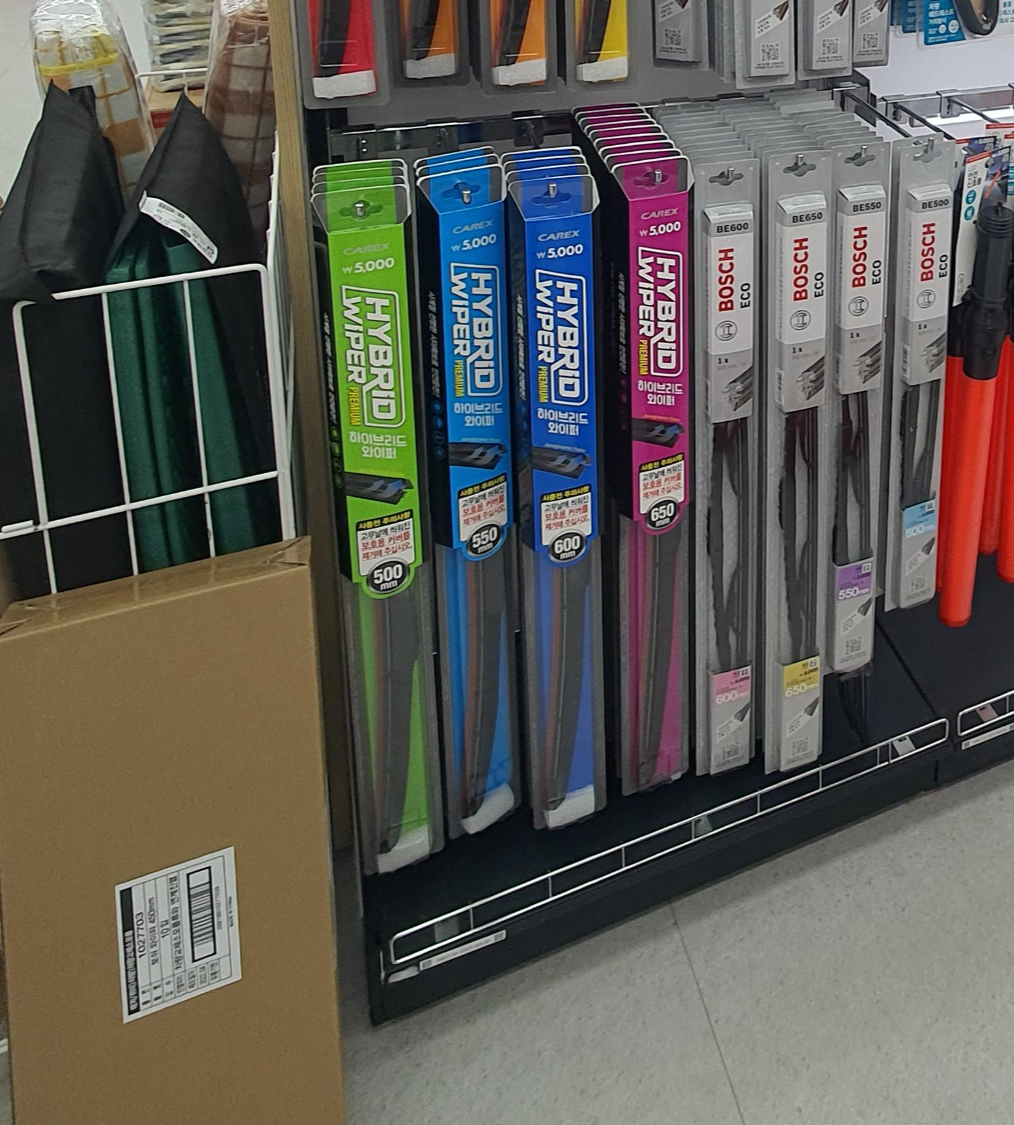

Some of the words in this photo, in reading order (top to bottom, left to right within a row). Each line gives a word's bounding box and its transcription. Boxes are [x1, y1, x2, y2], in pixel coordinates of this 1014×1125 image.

[641, 207, 679, 220] CAREX
[852, 201, 882, 212] BE550
[921, 198, 949, 209] BE500
[716, 222, 749, 234] BE600
[792, 211, 823, 223] BE650
[538, 229, 580, 242] CAREX
[851, 225, 868, 288] BOSCH
[920, 222, 936, 282] BOSCH
[793, 237, 809, 301] BOSCH
[871, 259, 882, 285] ECO
[939, 254, 949, 279] ECO
[717, 247, 735, 312] BOSCH
[814, 271, 825, 298] ECO
[638, 256, 655, 337] WIPER
[740, 282, 751, 309] ECO
[450, 272, 470, 356] WIPER
[535, 279, 555, 363] WIPER
[656, 257, 677, 370] HYBRID
[342, 295, 367, 385] WIPER
[471, 272, 495, 388] HYBRID
[556, 281, 580, 398] HYBRID
[365, 298, 397, 420] HYBRID
[537, 366, 548, 403] PREMIUM
[637, 379, 684, 395] 하이브리드
[349, 387, 361, 426] PREMIUM
[453, 402, 503, 415] 하이브리드
[647, 393, 675, 406] 와이퍼
[464, 416, 495, 427] 와이퍼
[536, 407, 589, 424] 하이브리드
[349, 431, 407, 447] 하이브리드
[547, 424, 580, 436] 와이퍼
[362, 446, 397, 459] 와이퍼
[650, 502, 675, 521] 650
[472, 527, 498, 548] 550
[554, 536, 581, 553] 600
[373, 564, 403, 583] 500
[838, 587, 870, 600] 550mm
[147, 896, 156, 925] 450mm
[135, 911, 147, 958] 1027703
[149, 925, 157, 948] 와이퍼
